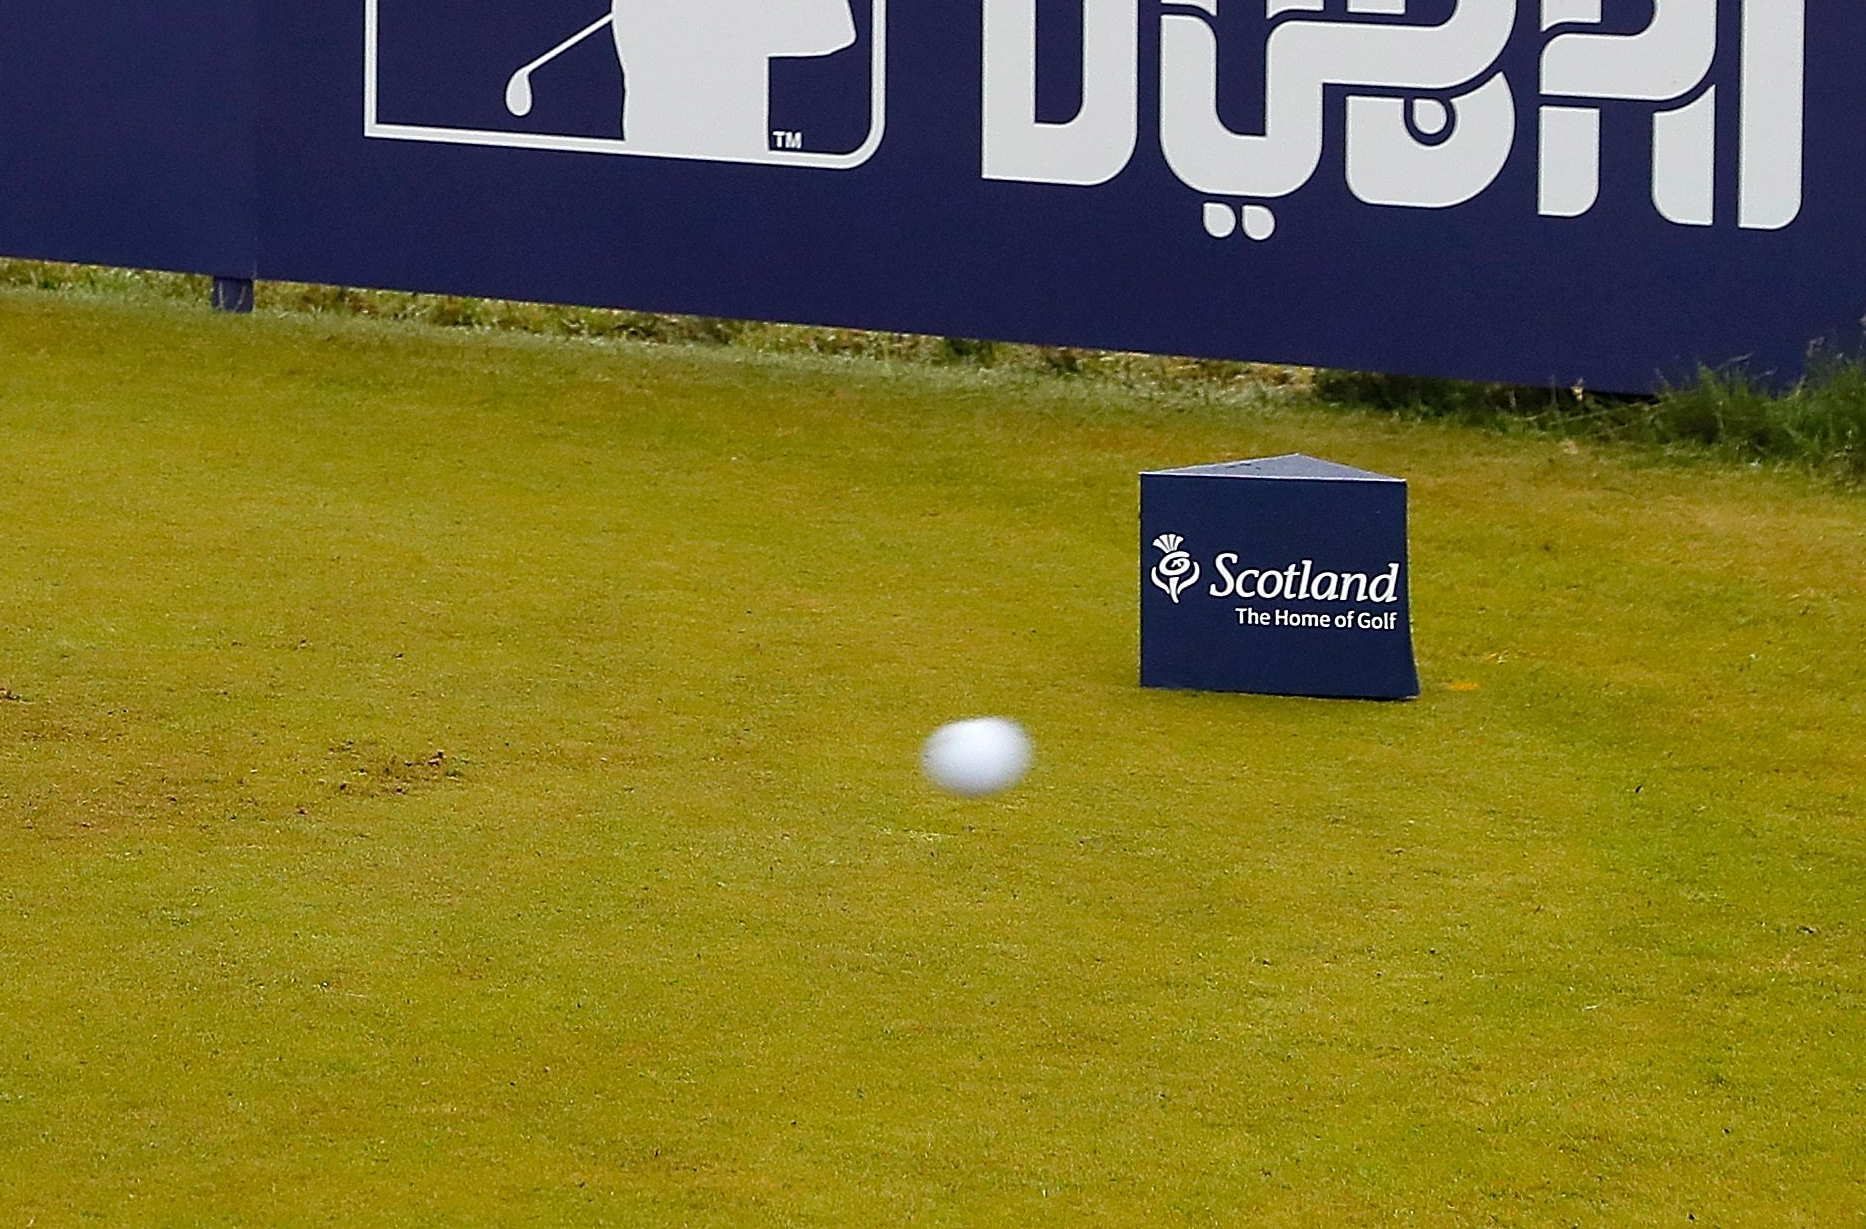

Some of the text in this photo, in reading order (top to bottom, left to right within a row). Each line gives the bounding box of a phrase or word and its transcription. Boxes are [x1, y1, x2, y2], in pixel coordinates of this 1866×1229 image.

[772, 131, 802, 149] TM
[1209, 552, 1400, 603] Scotland
[1235, 607, 1398, 630] The Home of Golf
